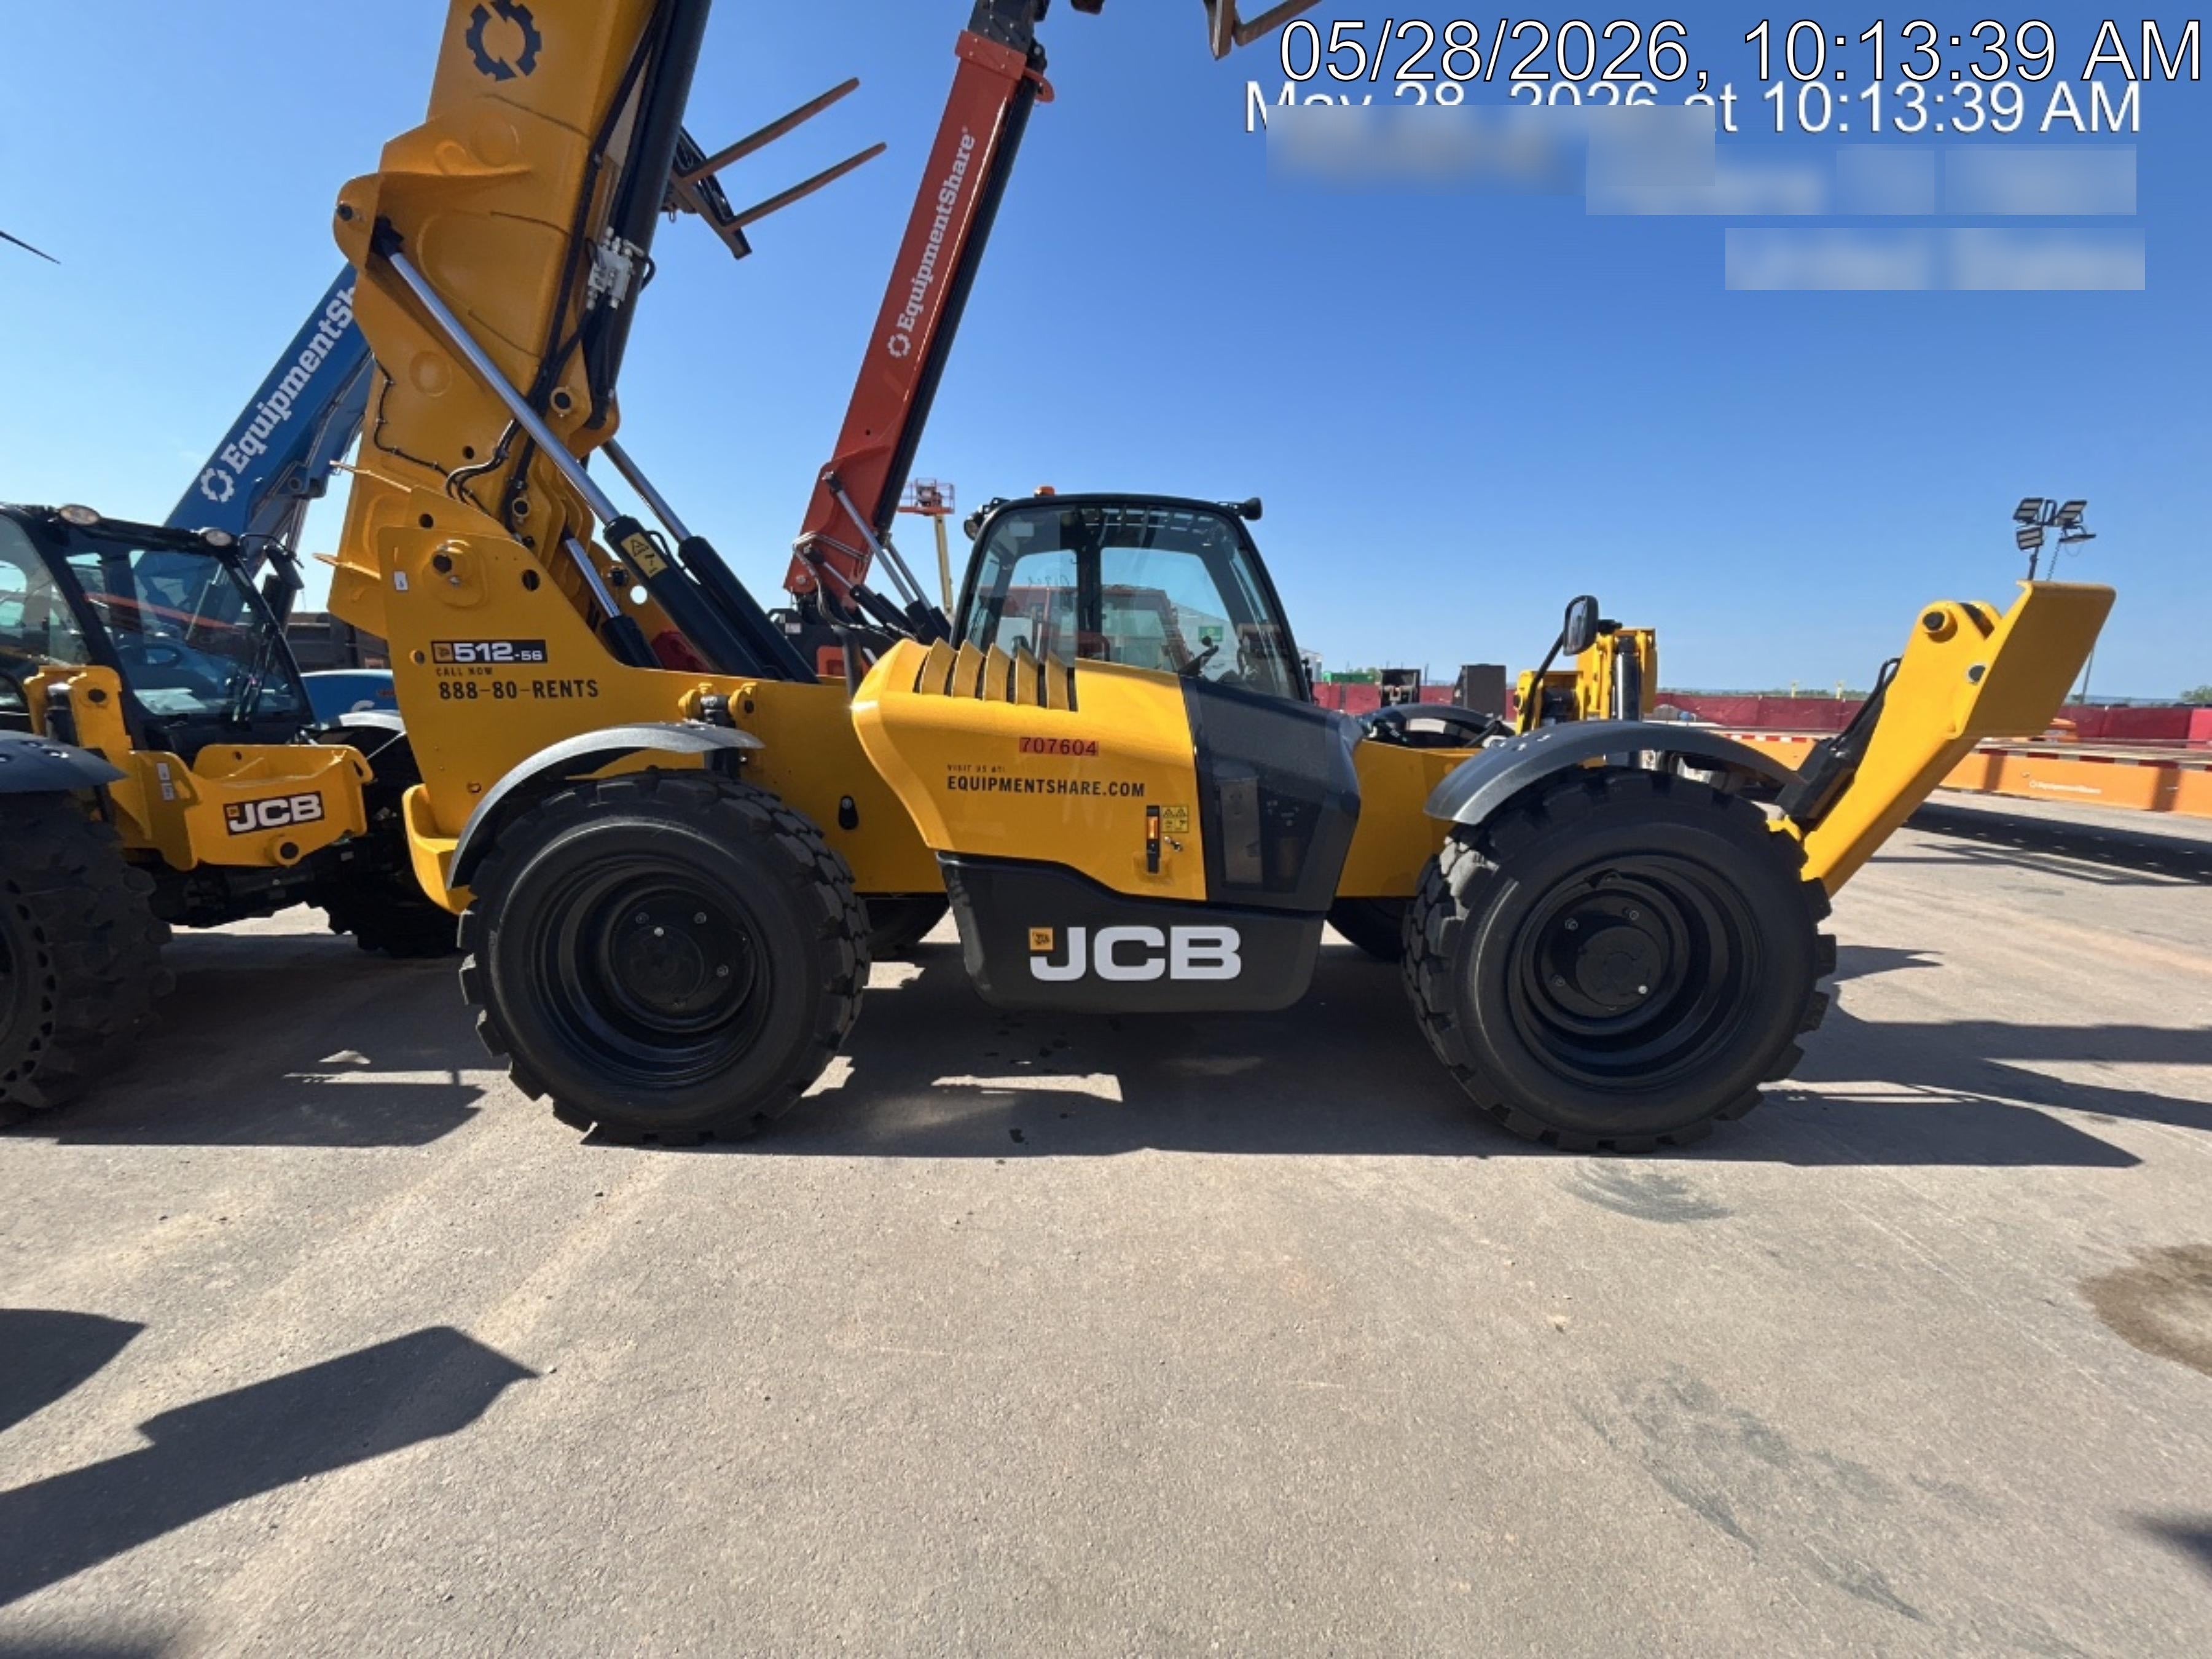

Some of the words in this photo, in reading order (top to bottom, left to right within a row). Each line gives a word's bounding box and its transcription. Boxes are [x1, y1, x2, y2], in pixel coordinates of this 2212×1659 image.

[896, 134, 976, 332] EquipmentShare
[436, 667, 463, 677] CALL
[468, 666, 493, 676] NOW
[438, 679, 599, 699] 888-80-RENTS
[1020, 737, 1097, 756] 707604
[947, 775, 1146, 797] EQUIPMENTSHARE.COM
[228, 793, 322, 833] JCB
[1029, 925, 1242, 982] JCB
